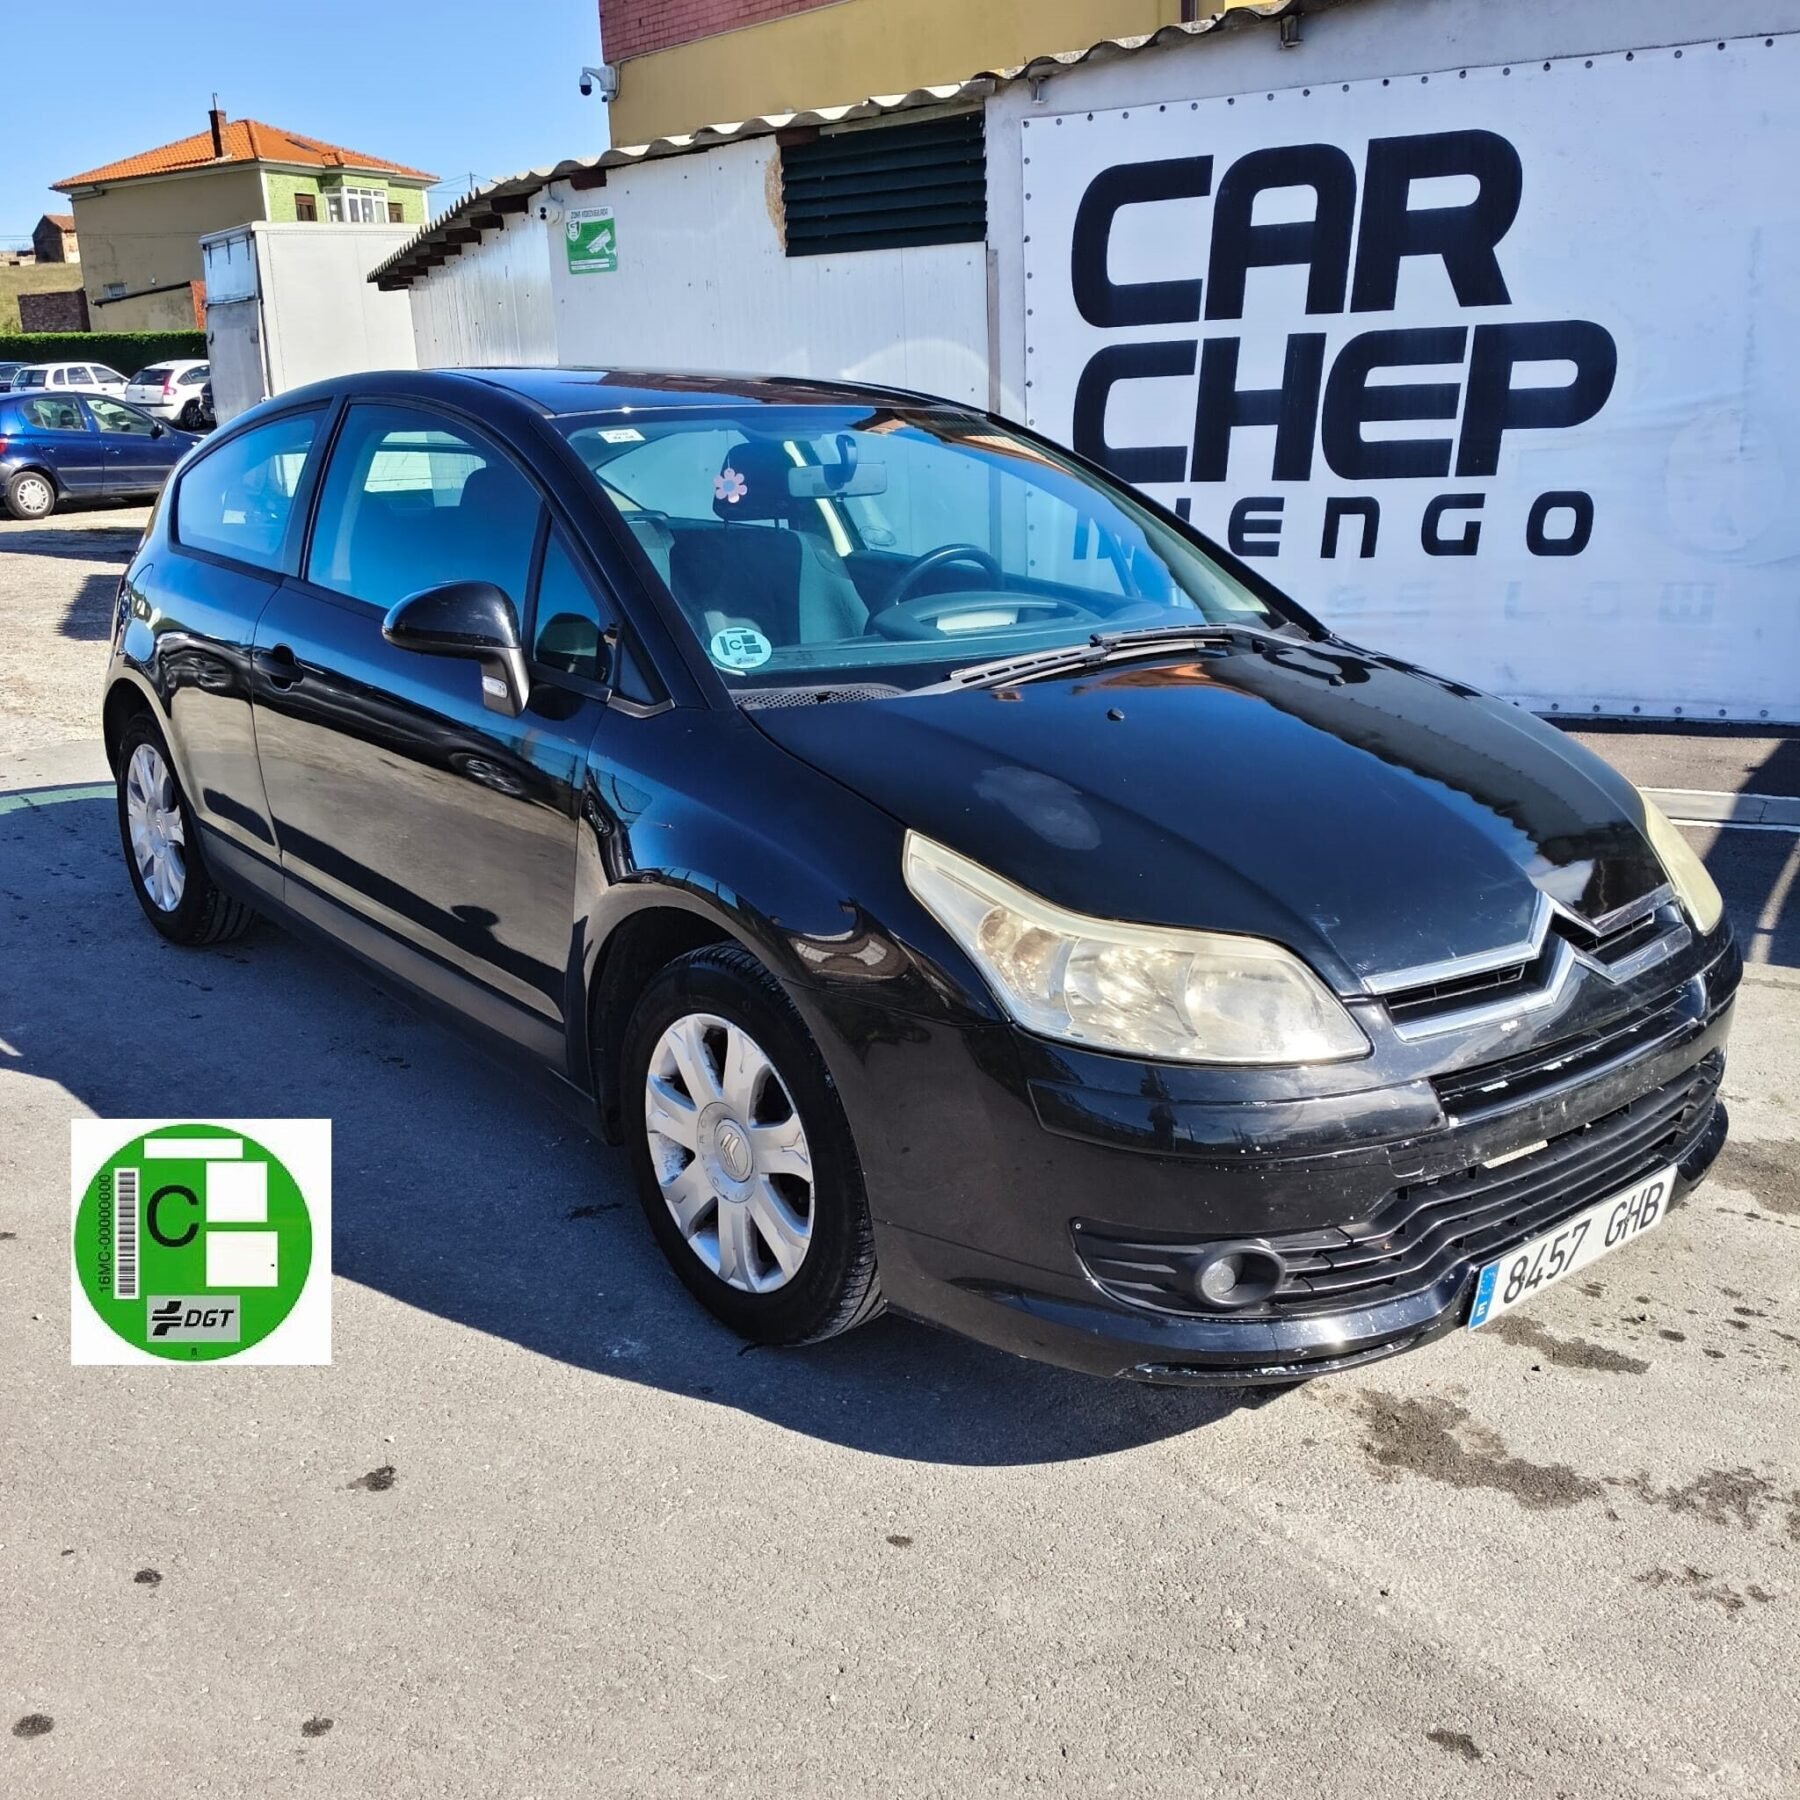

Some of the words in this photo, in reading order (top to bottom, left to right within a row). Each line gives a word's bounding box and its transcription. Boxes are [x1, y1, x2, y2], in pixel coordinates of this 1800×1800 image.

[1071, 129, 1523, 328] CAR
[1072, 320, 1617, 483] CHEP
[1477, 1302, 1488, 1316] E
[1503, 1218, 1592, 1304] 8457
[1604, 1181, 1665, 1248] GHB
